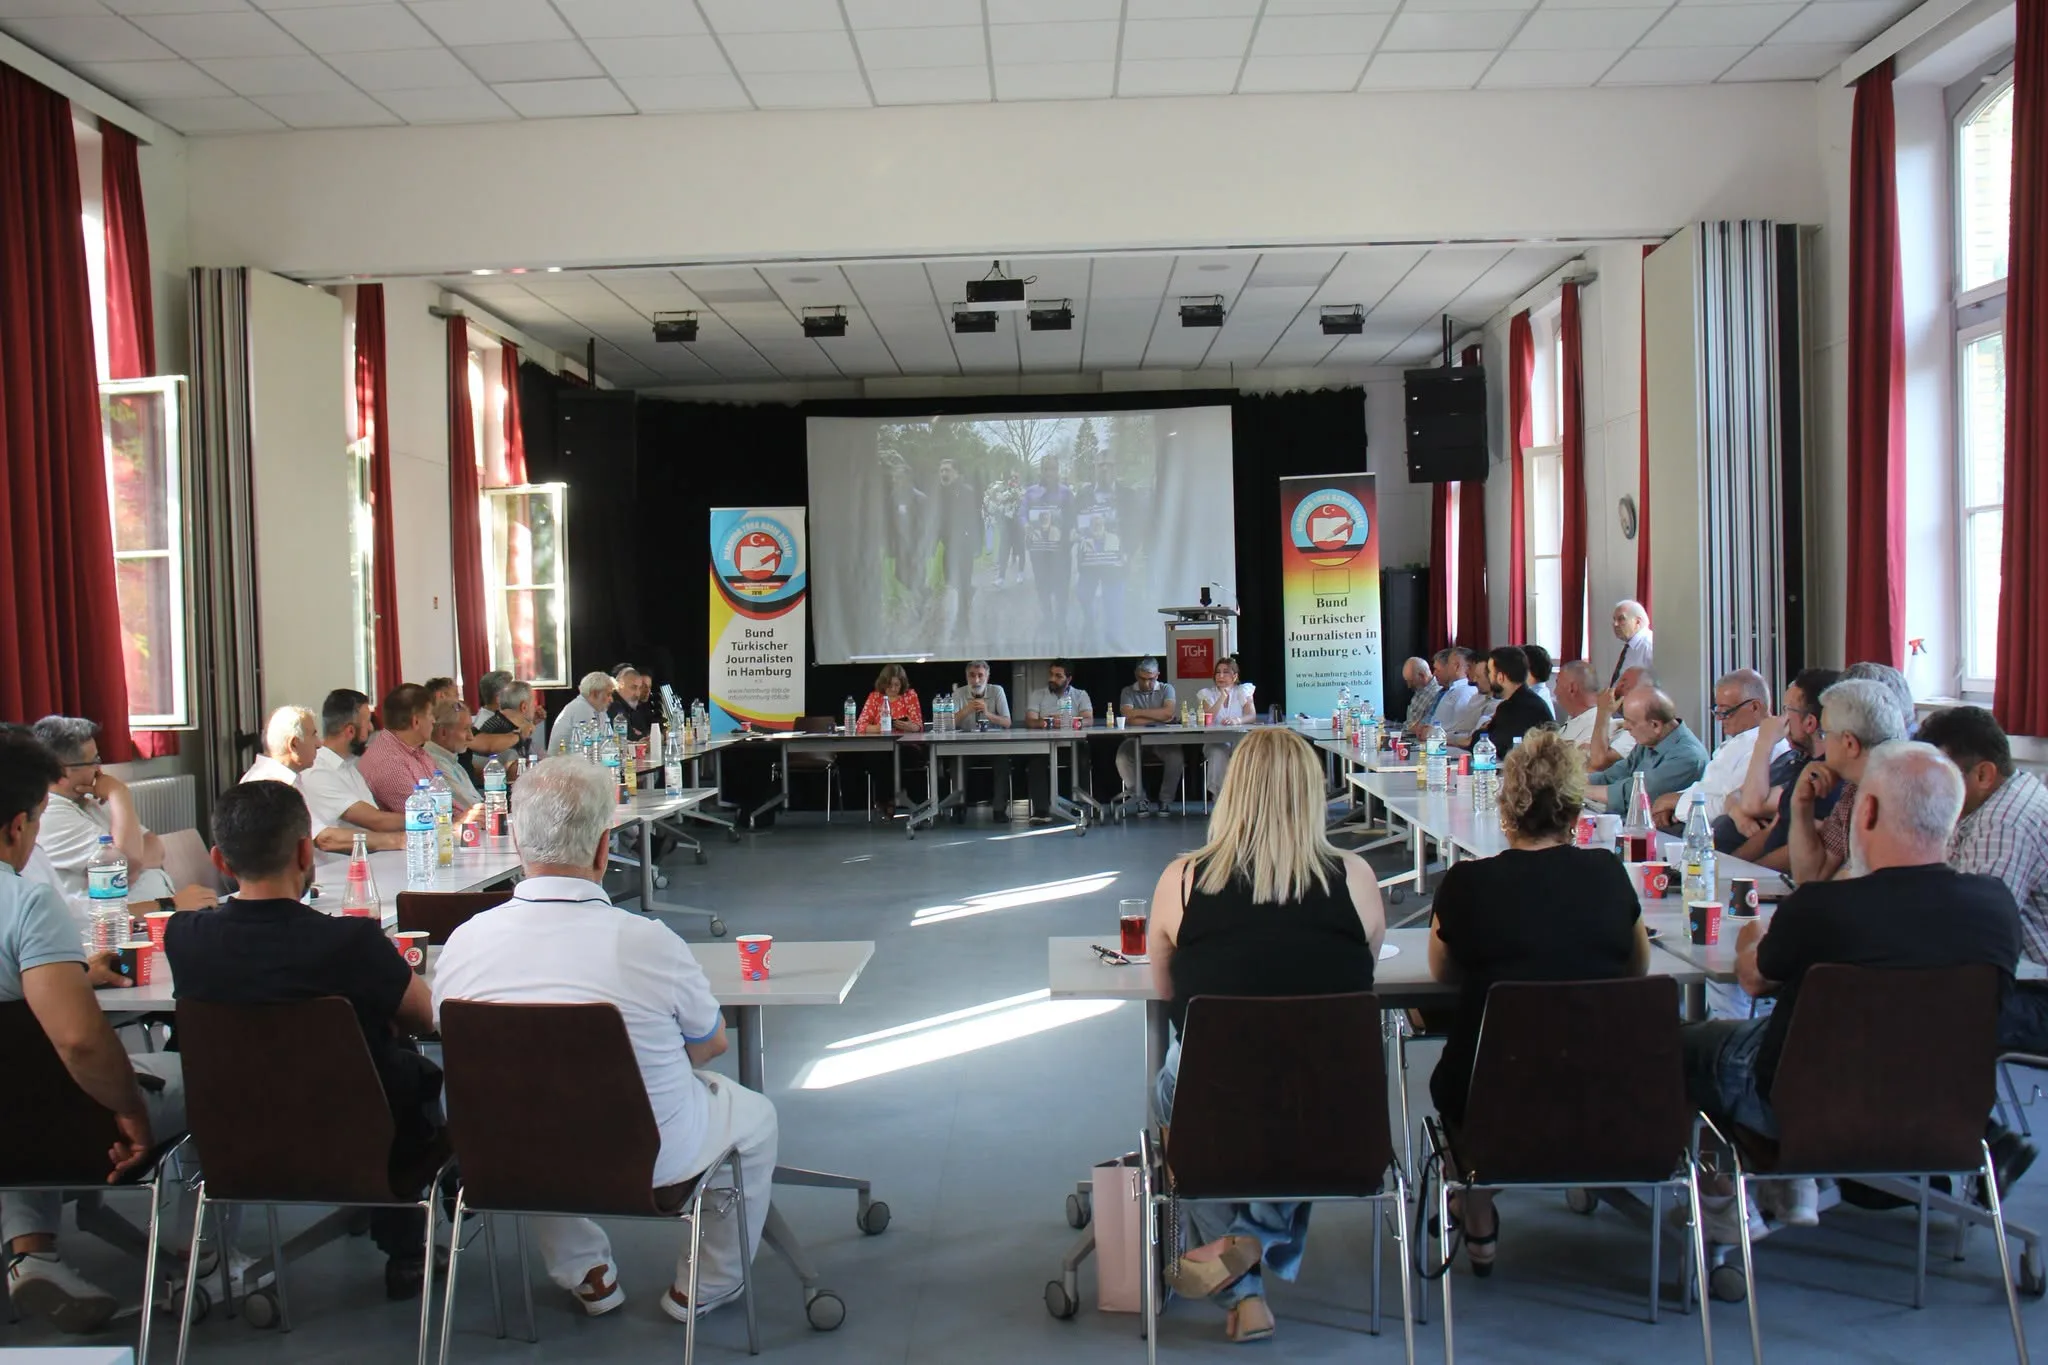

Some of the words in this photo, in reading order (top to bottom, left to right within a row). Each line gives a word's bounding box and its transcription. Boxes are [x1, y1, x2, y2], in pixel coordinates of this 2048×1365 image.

[1316, 597, 1348, 608] Bund
[1300, 613, 1366, 625] Türkischer
[745, 628, 774, 638] Bund
[1288, 630, 1362, 642] Journalisten
[1366, 628, 1377, 639] in
[731, 641, 788, 651] Türkischer
[1182, 645, 1207, 657] TGH
[726, 654, 793, 664] Journalisten
[1291, 647, 1348, 659] Hamburg
[727, 667, 738, 677] in
[740, 666, 792, 678] Hamburg
